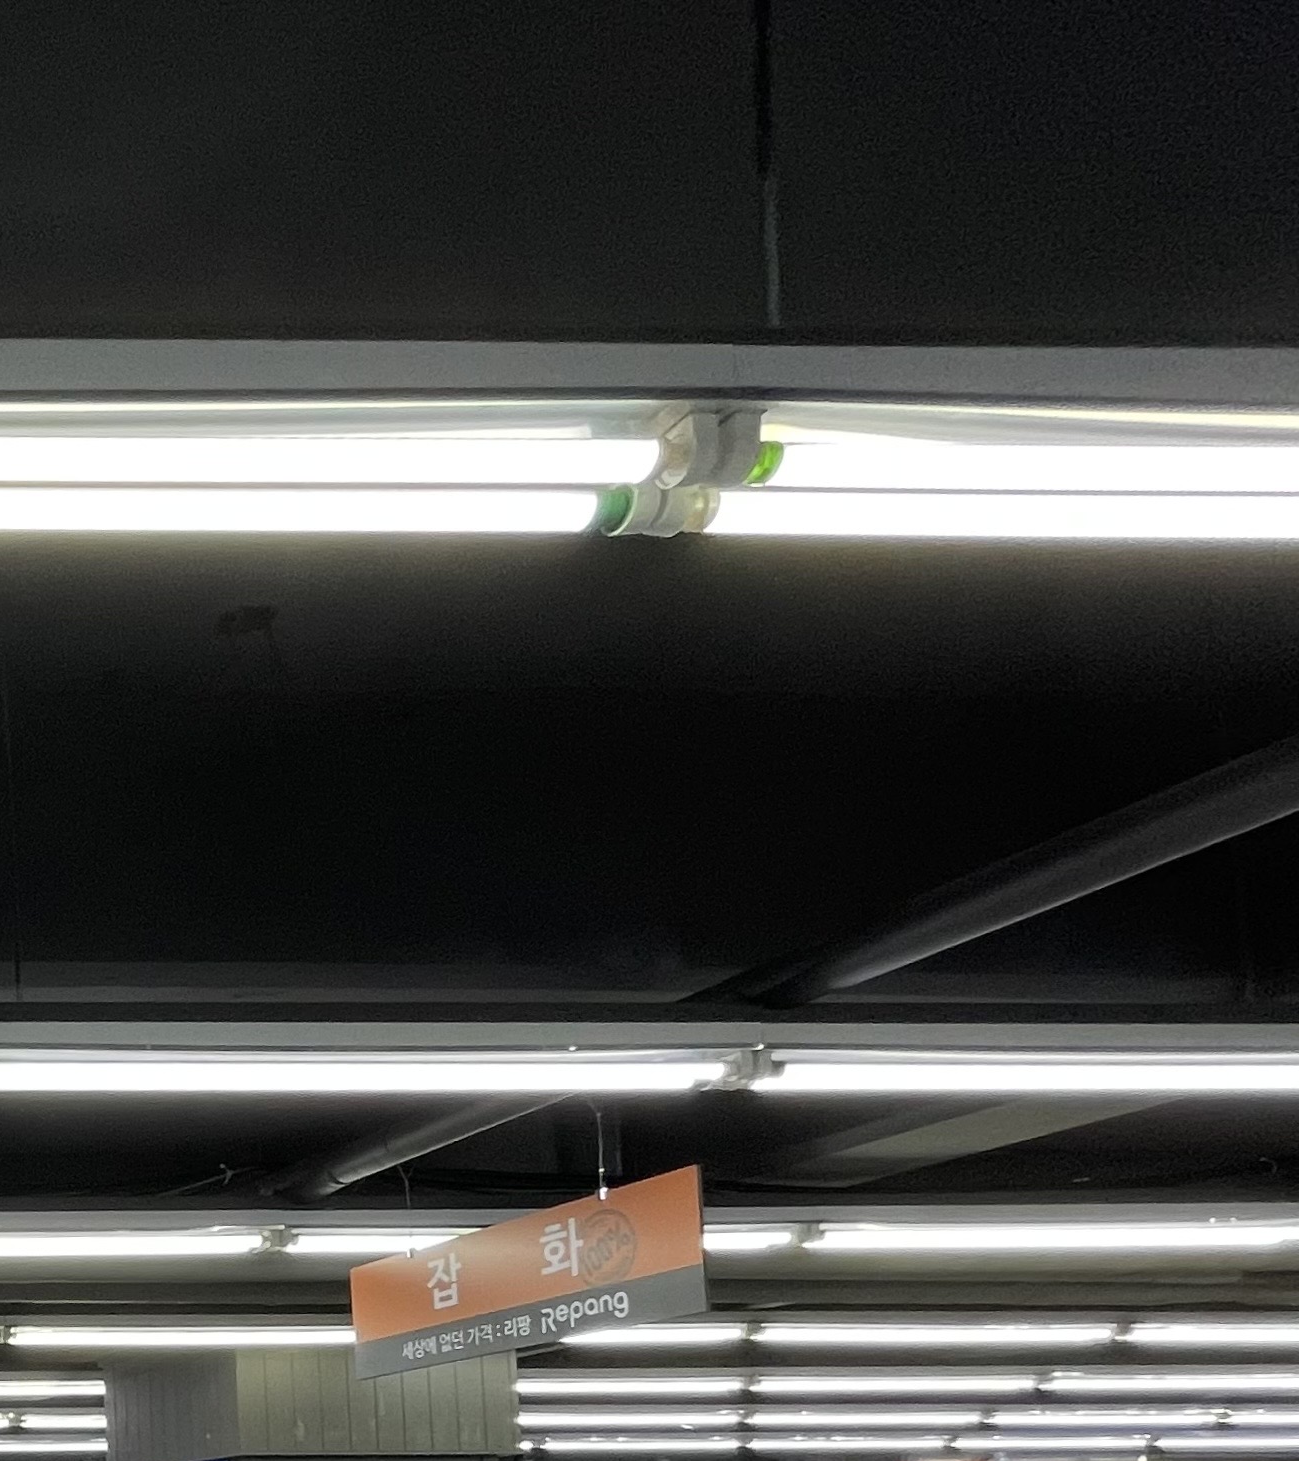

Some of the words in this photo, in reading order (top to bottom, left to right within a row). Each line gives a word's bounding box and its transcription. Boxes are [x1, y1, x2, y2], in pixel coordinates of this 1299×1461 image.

[540, 1291, 629, 1334] Repang
[403, 1338, 437, 1360] 세상에
[439, 1331, 465, 1352] 없던
[504, 1314, 533, 1337] 리팡
